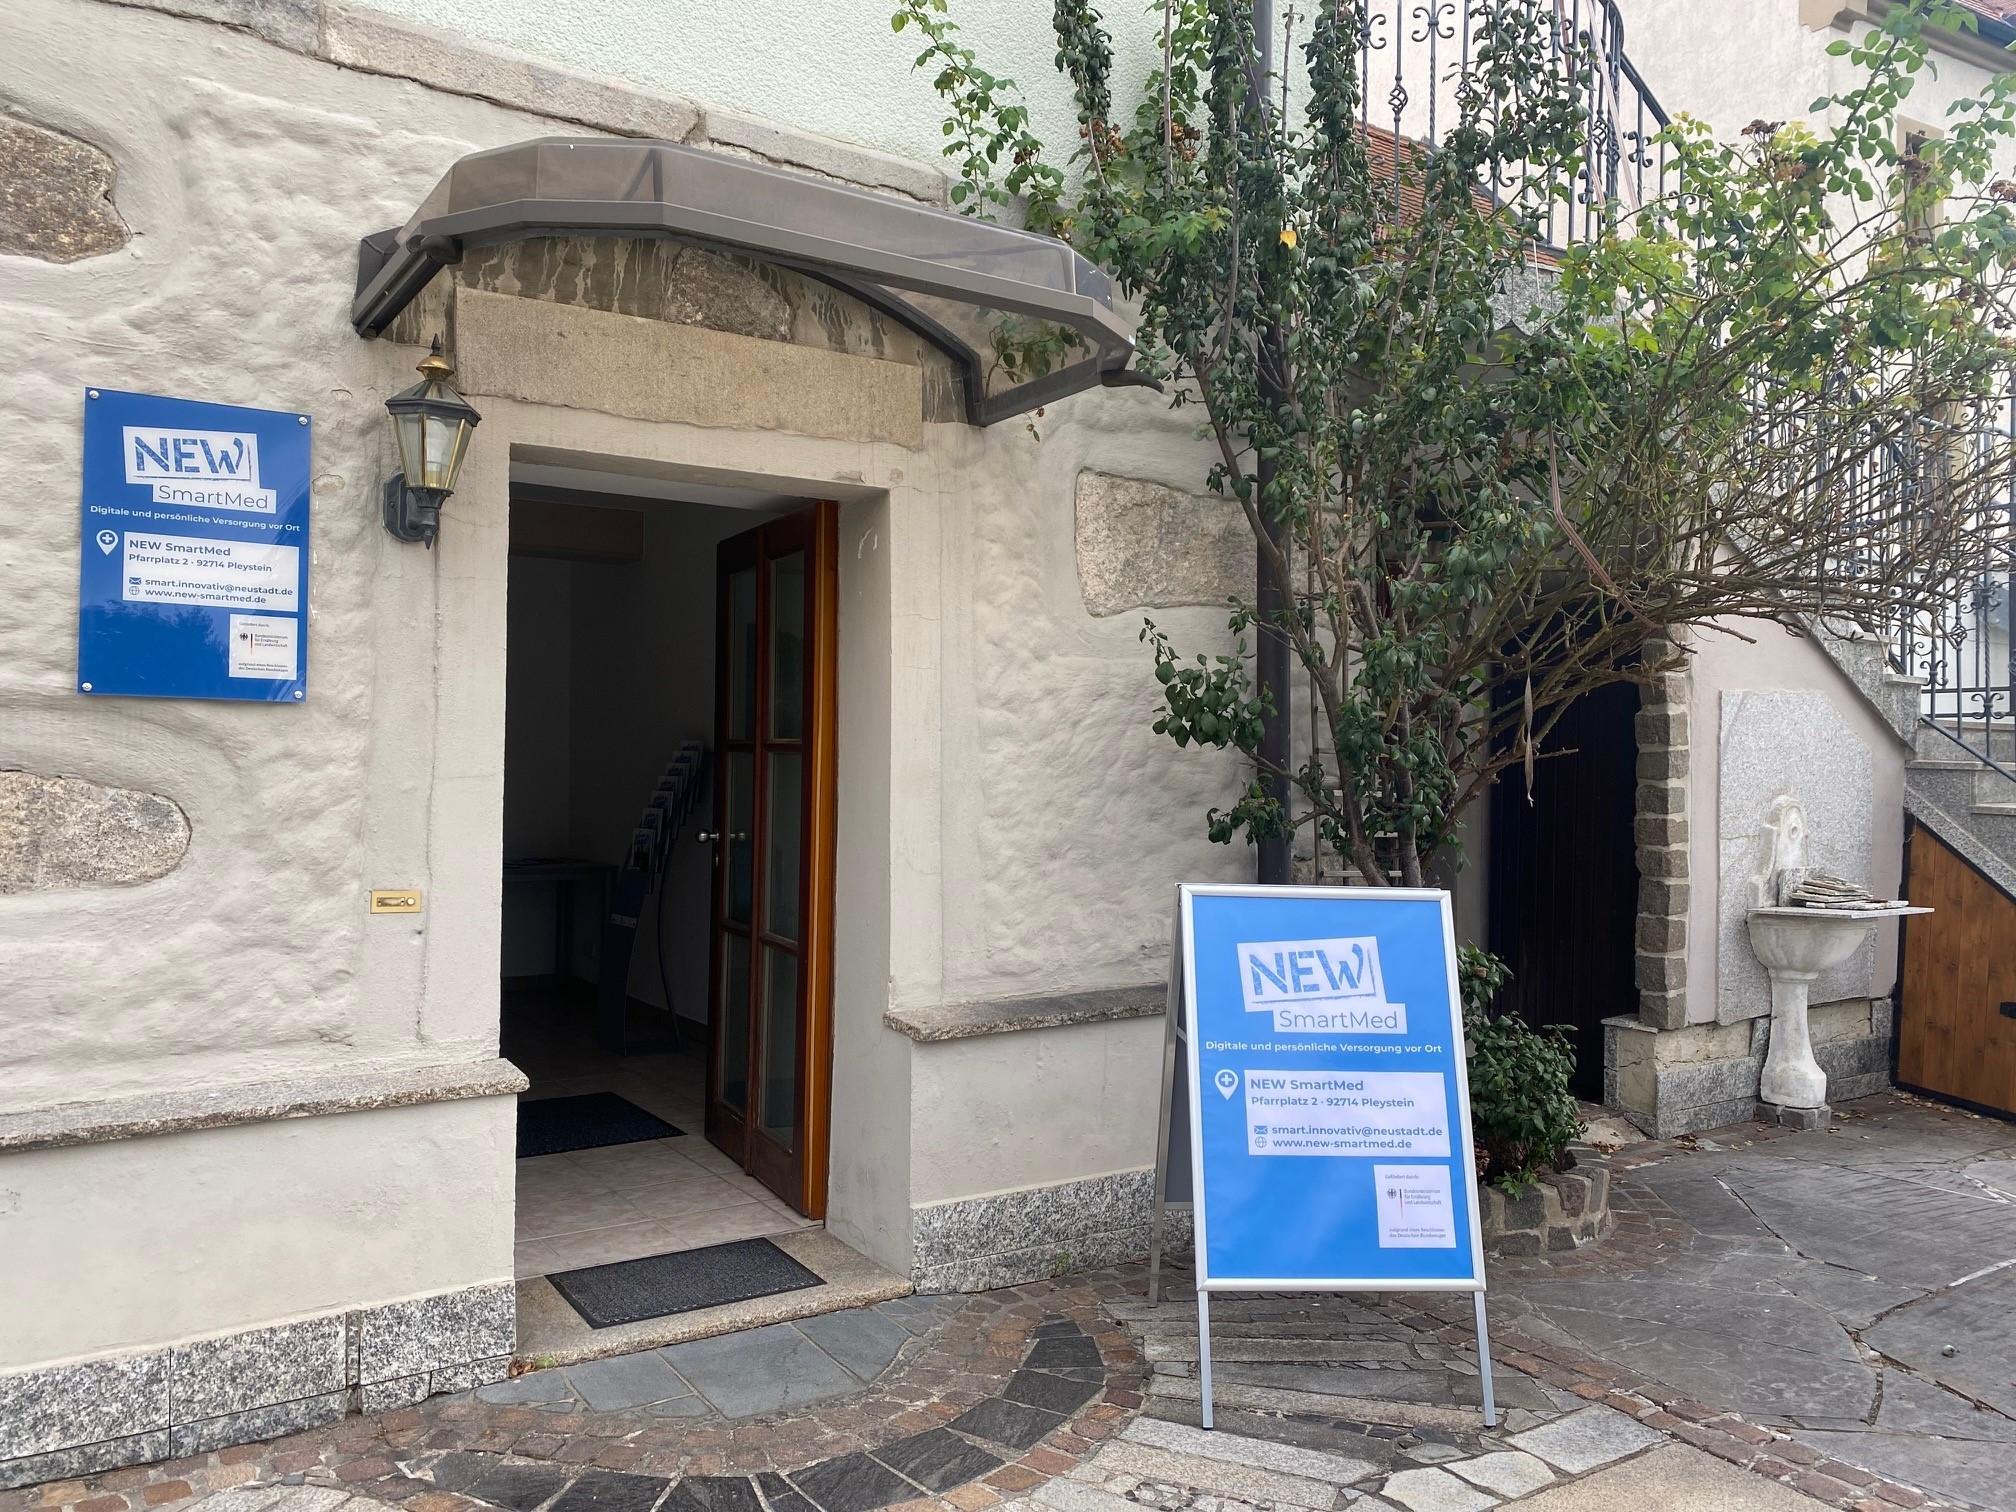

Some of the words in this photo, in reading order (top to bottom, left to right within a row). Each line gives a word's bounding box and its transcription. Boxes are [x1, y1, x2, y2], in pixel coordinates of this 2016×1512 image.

[135, 436, 244, 474] NEW
[158, 484, 268, 509] SmartMed
[90, 505, 129, 516] Digitale
[132, 509, 151, 518] und
[154, 511, 210, 523] persönliche
[212, 517, 266, 530] Versorgung
[285, 523, 300, 532] Ort
[129, 539, 161, 550] NEW
[165, 543, 231, 556] SmartMed
[128, 553, 180, 565] Pfarrplatz
[196, 559, 225, 568] 92714
[227, 561, 272, 572] Pleystein
[145, 578, 293, 596] smart.innovativ@neustadt.de
[145, 589, 266, 604] www.new-smartmed.de
[1249, 943, 1364, 996] NEW
[1279, 1010, 1398, 1029] SmartMed
[1206, 1041, 1248, 1051] Digitale
[1250, 1042, 1272, 1050] und
[1274, 1042, 1337, 1053] persönliche
[1339, 1043, 1402, 1054] Versorgung
[1424, 1044, 1442, 1053] Ort
[1250, 1079, 1286, 1090] NEW
[1290, 1079, 1364, 1091] SmartMed
[1251, 1096, 1308, 1108] Pfarrplatz
[1312, 1097, 1318, 1106] 2
[1326, 1098, 1359, 1107] 92714
[1361, 1098, 1415, 1109] Pleystein
[1272, 1125, 1443, 1137] smart.innovativ@neustadt.de
[1272, 1139, 1412, 1149] www.new-smartmed.de
